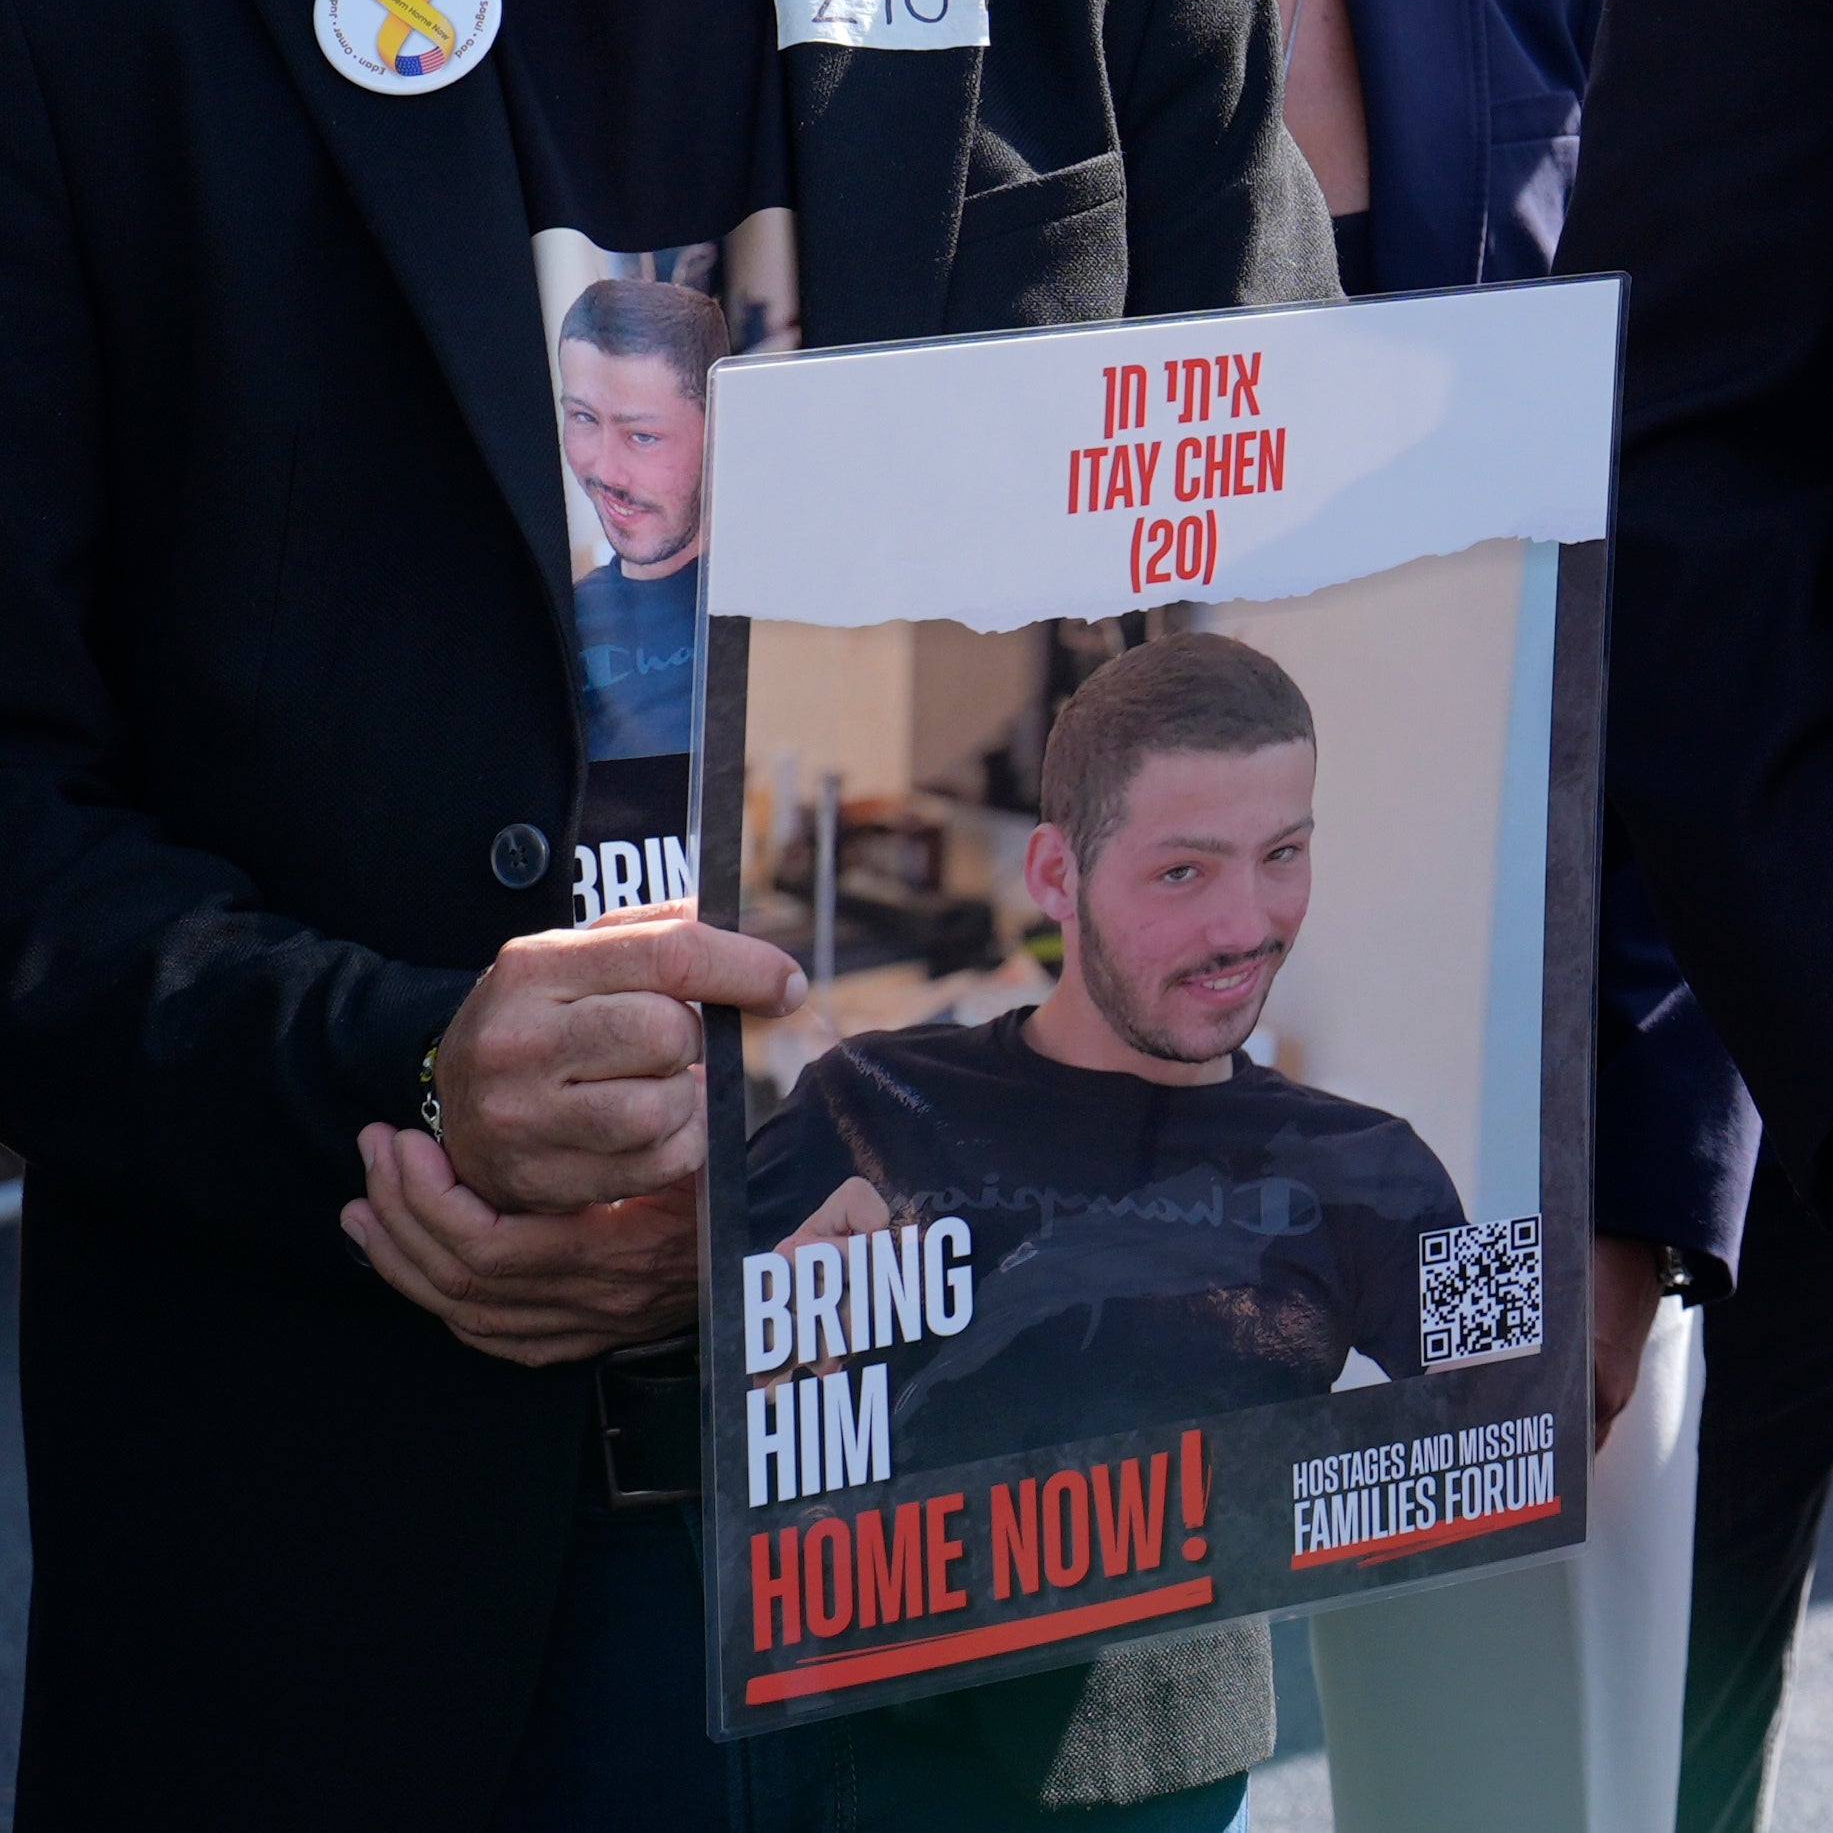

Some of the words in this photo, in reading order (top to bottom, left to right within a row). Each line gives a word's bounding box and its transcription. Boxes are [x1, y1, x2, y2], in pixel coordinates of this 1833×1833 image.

[333, 27, 353, 55] Omer
[358, 56, 386, 76] Edan
[408, 6, 432, 28] Home
[432, 22, 449, 41] Now
[1103, 364, 1148, 439] חן
[1165, 352, 1262, 423] איתי
[1067, 440, 1162, 514] ITAY
[1174, 427, 1286, 502] CHEN
[1130, 509, 1217, 594] (20)
[573, 834, 697, 928] BRIN
[742, 1216, 974, 1375] BRING
[746, 1362, 891, 1508] HIM
[1292, 1442, 1405, 1500] HOSTAGES
[1410, 1433, 1454, 1476] AND
[1459, 1413, 1554, 1466] MISSING
[750, 1492, 968, 1653] HOME
[990, 1429, 1211, 1601] NOW!
[1294, 1475, 1437, 1556] FAMILIES
[1445, 1451, 1554, 1524] FORUM
